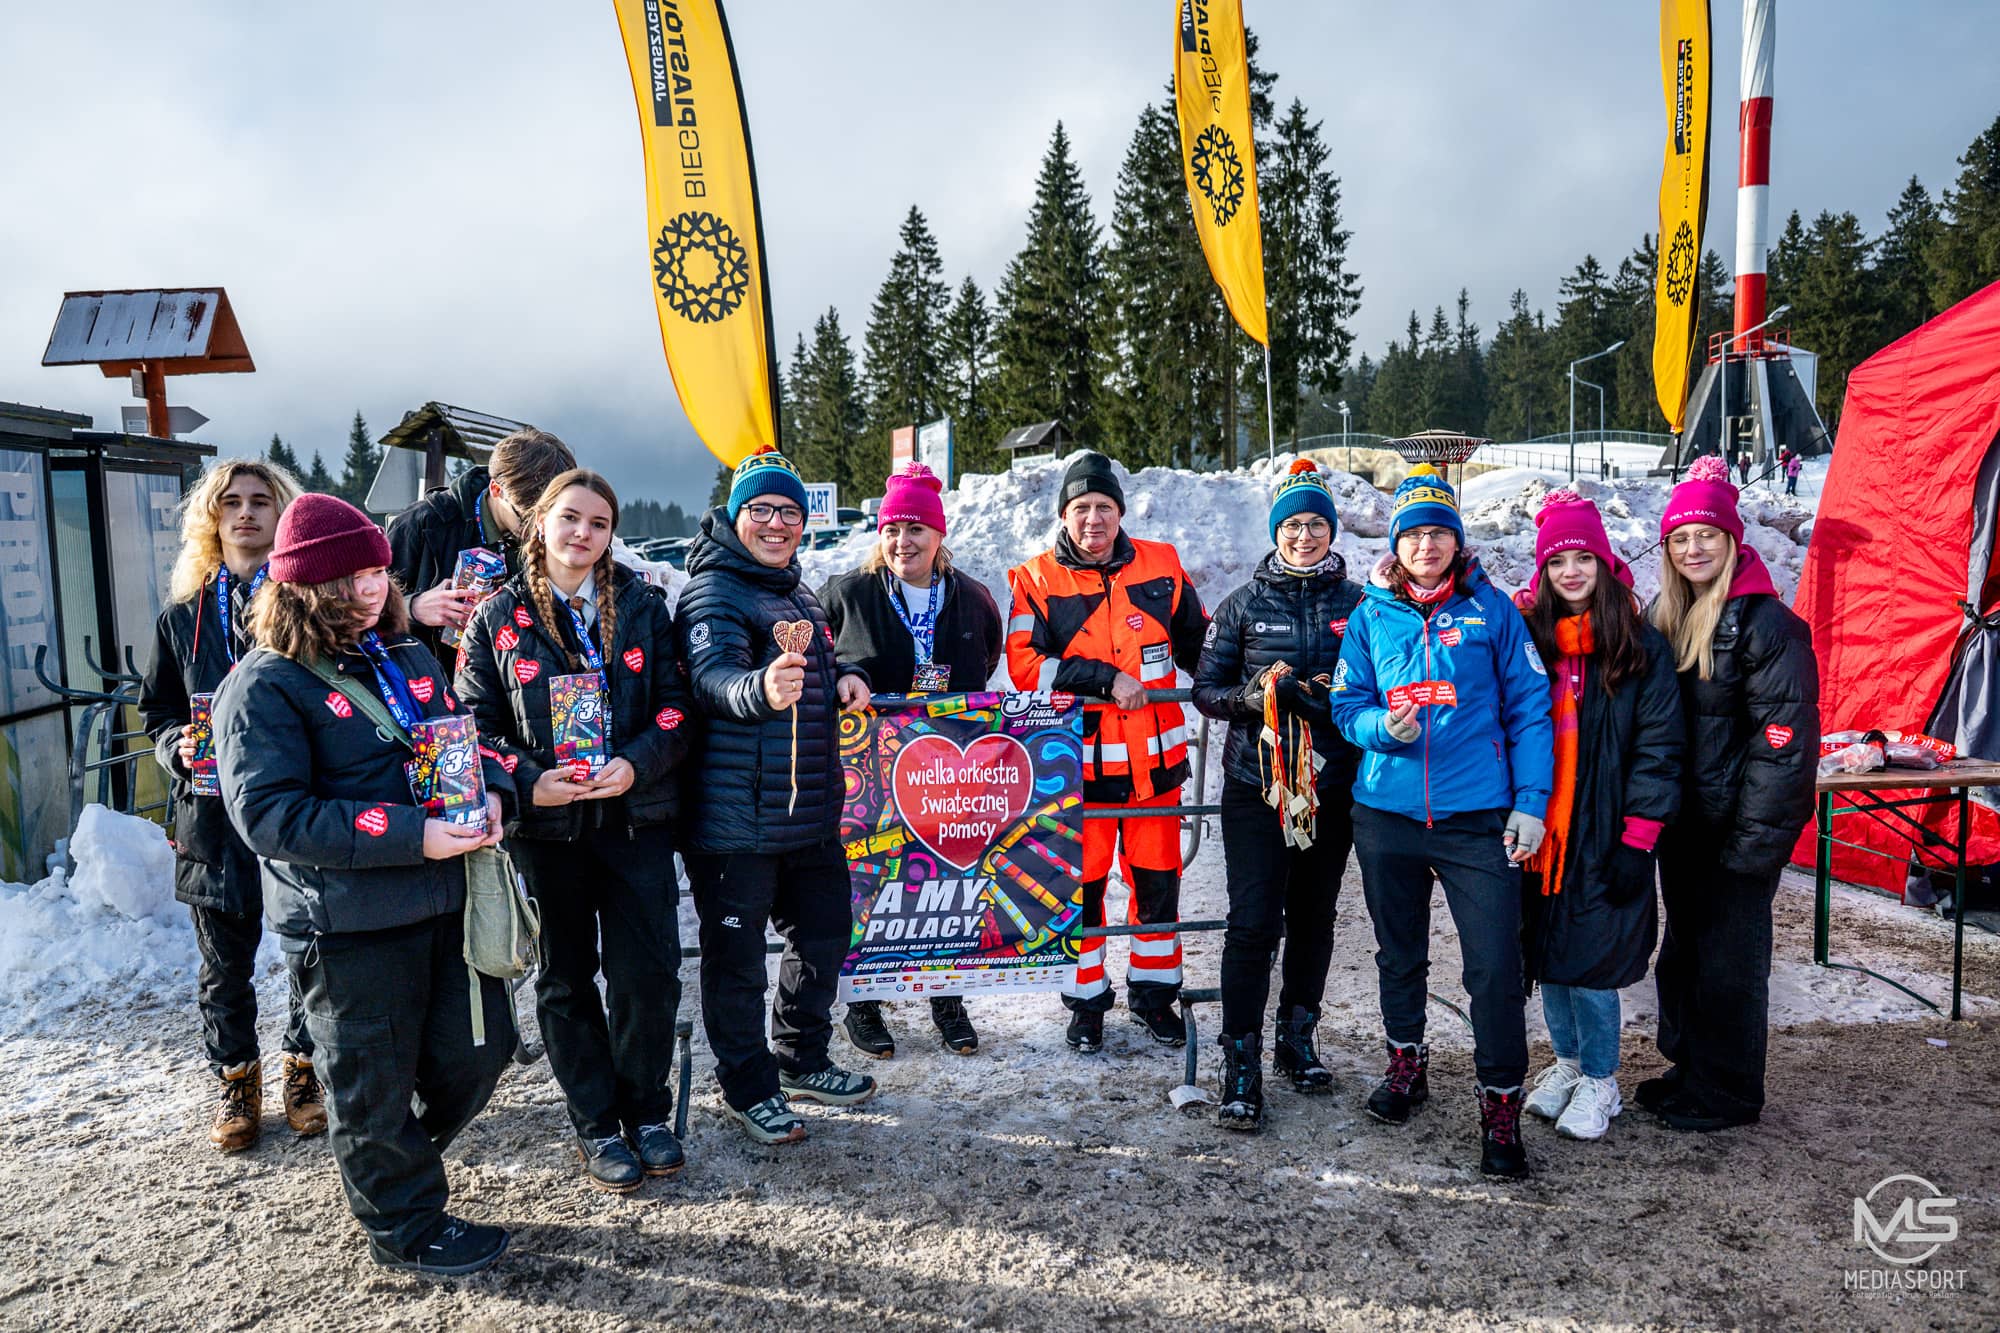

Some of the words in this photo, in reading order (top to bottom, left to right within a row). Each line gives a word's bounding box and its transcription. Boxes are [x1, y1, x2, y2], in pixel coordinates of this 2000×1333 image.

[807, 490, 830, 513] ART
[1012, 719, 1024, 728] 25
[1024, 718, 1064, 726] STYCZNIA
[907, 759, 955, 786] wielka
[958, 759, 1020, 785] orkiestra
[920, 789, 1010, 821] świątecznej
[938, 819, 997, 845] pomocy
[871, 881, 904, 914] A
[915, 878, 989, 913] MY,
[864, 915, 982, 942] POLACY,
[861, 944, 907, 954] POMAGANIE
[908, 943, 934, 951] MAMY
[855, 961, 902, 971] CHOROBY
[901, 958, 954, 968] PRZEWODU
[954, 956, 1027, 966] POKARMOWEGO
[1028, 955, 1036, 963] U
[1036, 953, 1066, 962] DZIECI
